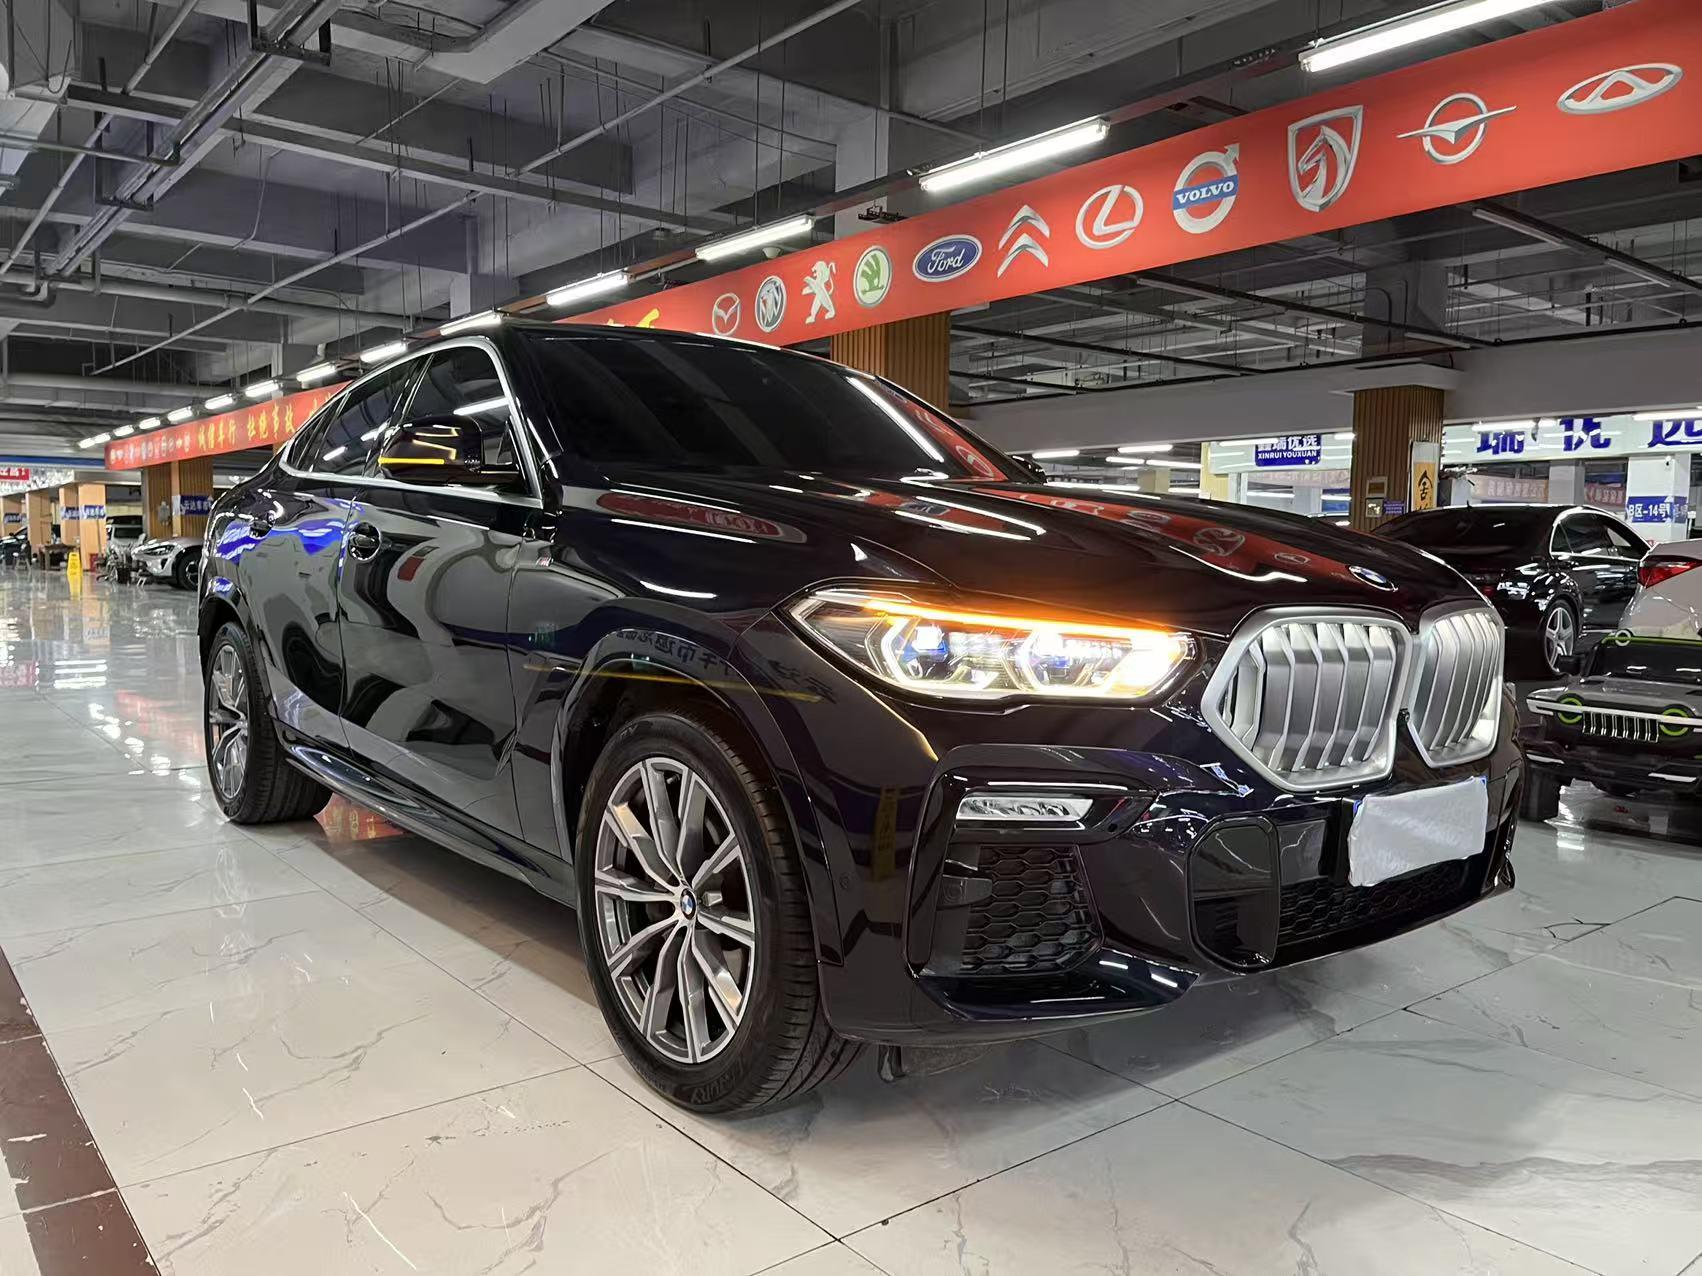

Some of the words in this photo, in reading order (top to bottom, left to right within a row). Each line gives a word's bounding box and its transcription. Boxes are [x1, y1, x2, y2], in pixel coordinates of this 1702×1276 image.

[1176, 181, 1234, 204] VOLVO
[927, 245, 966, 274] Ford
[1257, 451, 1282, 460] XINRUI
[1283, 450, 1317, 459] YOUXUAN
